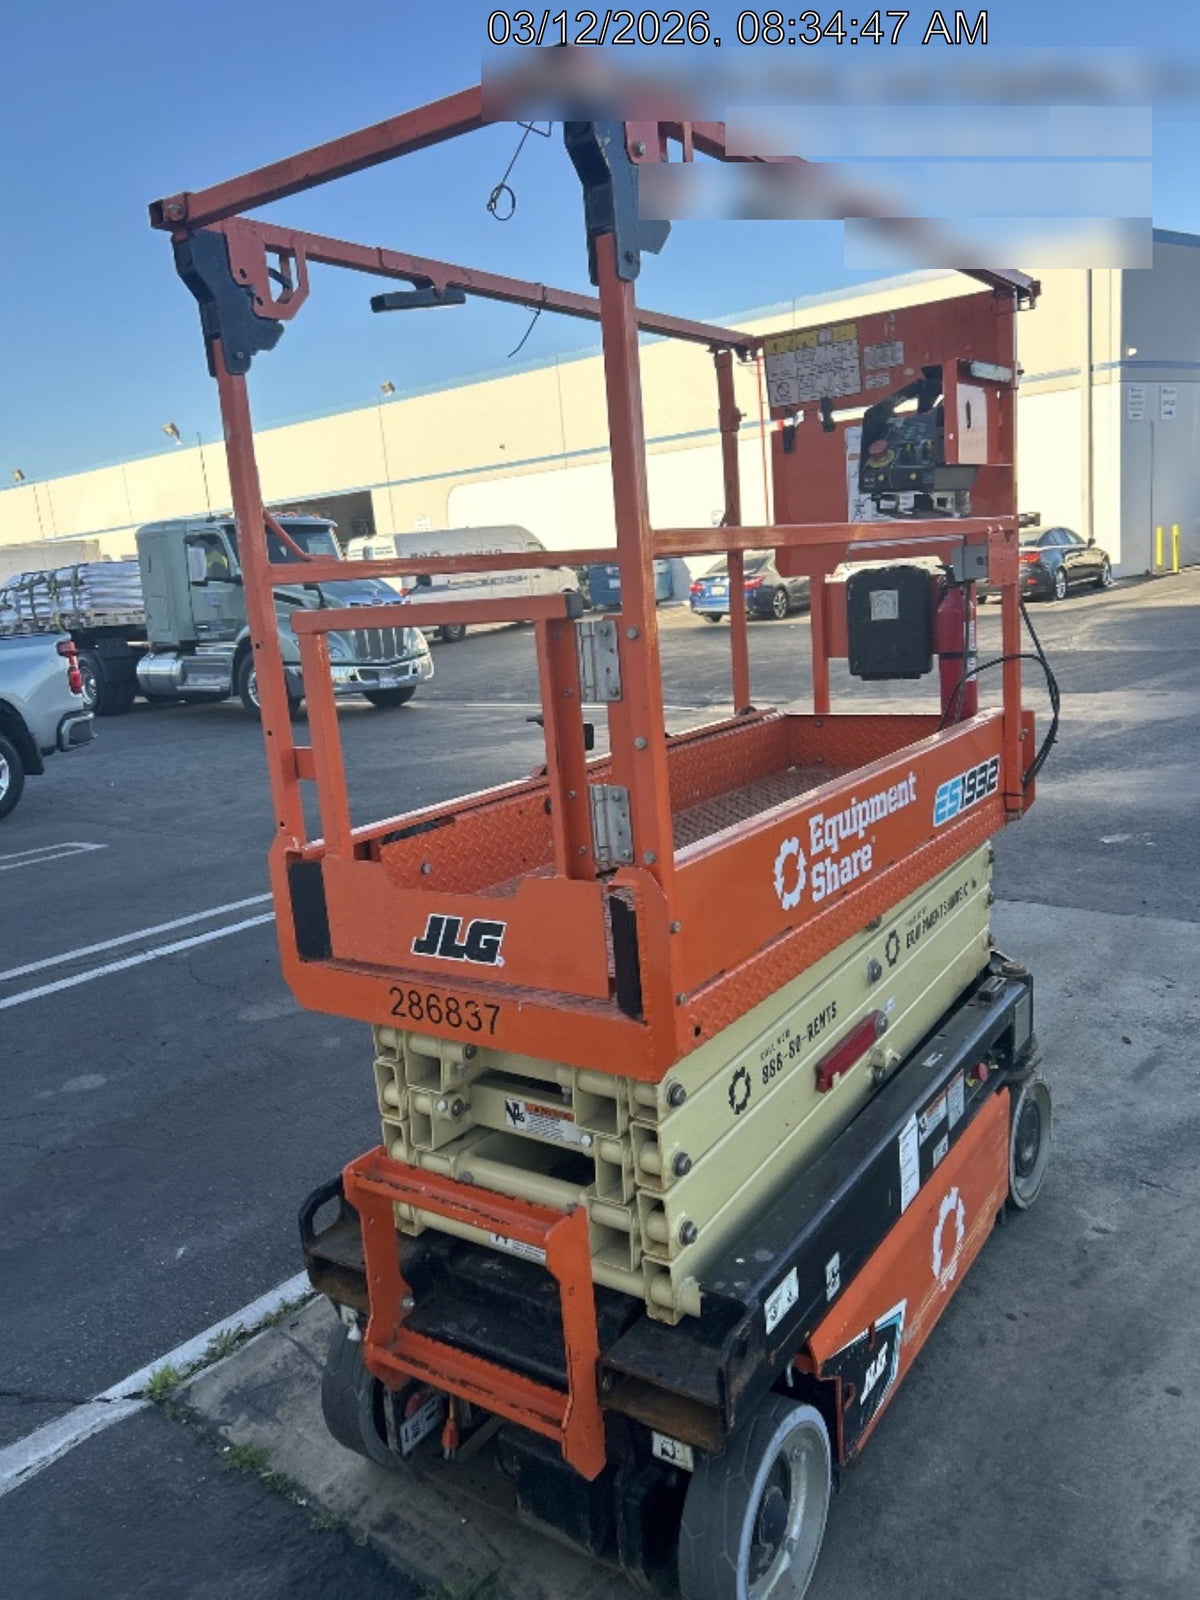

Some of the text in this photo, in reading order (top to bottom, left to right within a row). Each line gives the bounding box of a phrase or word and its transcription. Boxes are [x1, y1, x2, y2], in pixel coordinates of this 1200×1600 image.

[808, 771, 917, 857] Equipment
[933, 754, 1000, 827] ES1932
[811, 843, 873, 903] Share
[411, 913, 507, 966] JLG
[389, 986, 500, 1035] 286837
